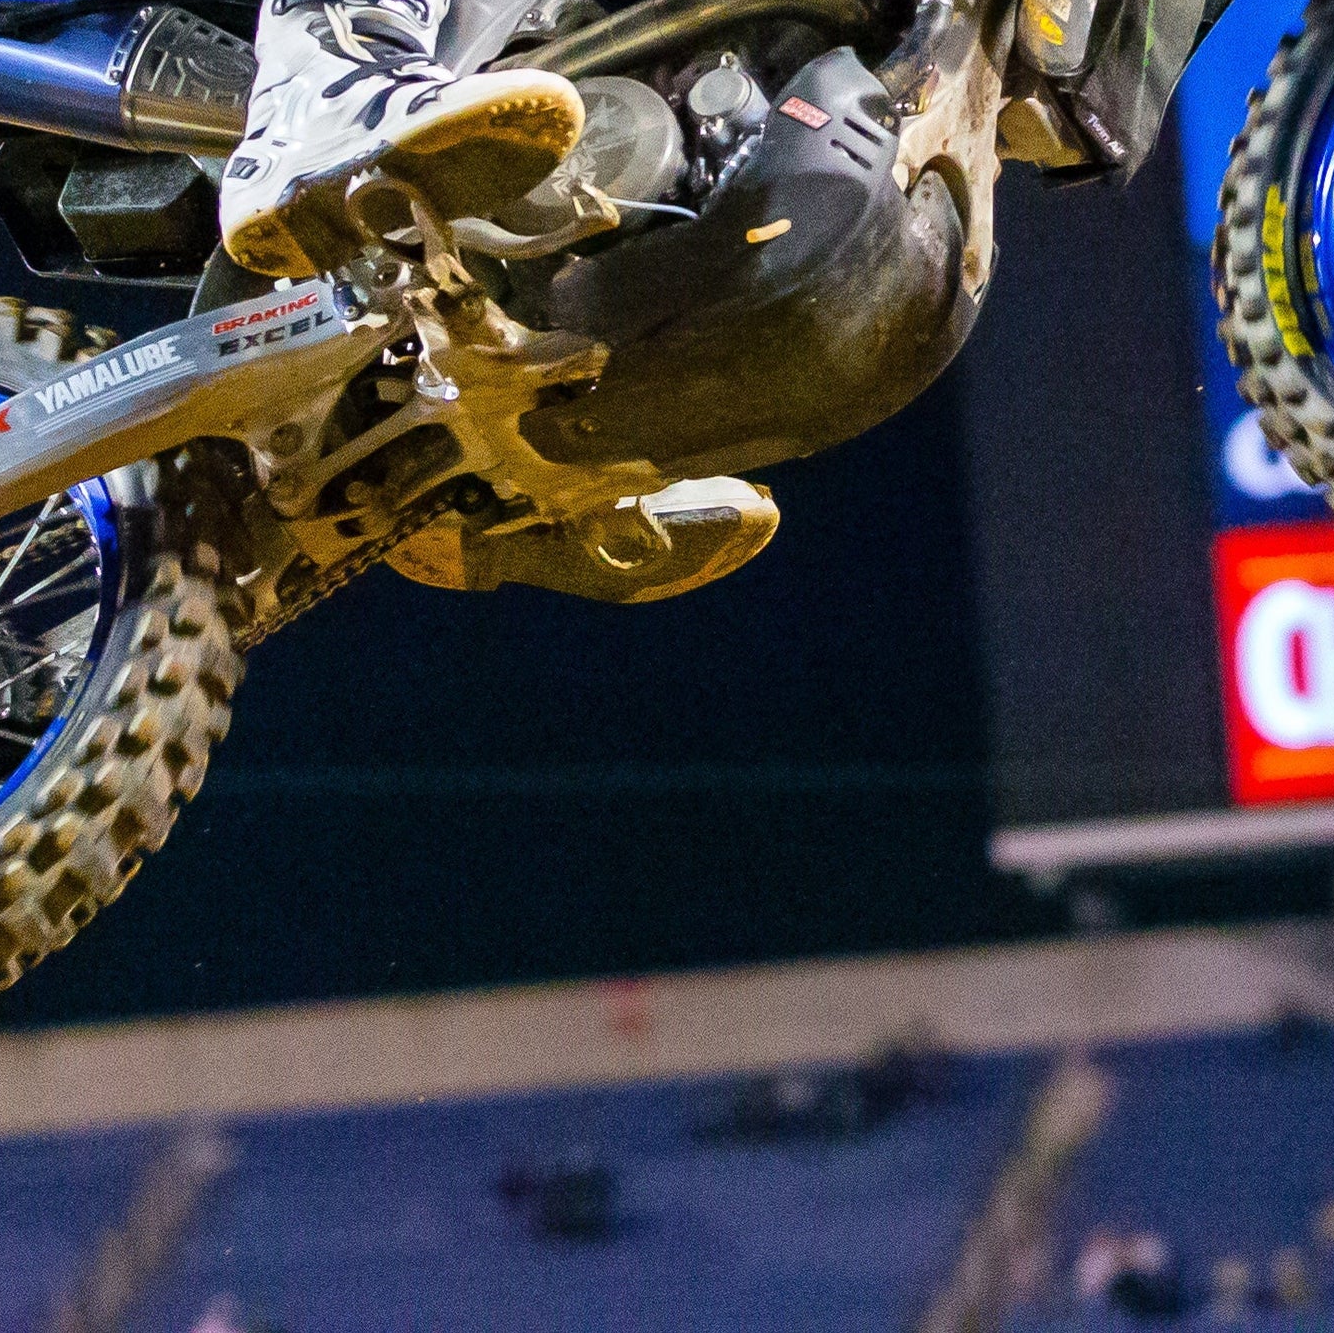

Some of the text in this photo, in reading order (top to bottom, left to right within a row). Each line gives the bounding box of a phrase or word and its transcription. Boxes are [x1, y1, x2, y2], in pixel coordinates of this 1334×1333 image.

[212, 291, 319, 336] BRAKING
[217, 311, 334, 358] EXCEL
[33, 333, 183, 415] YAMALUBE
